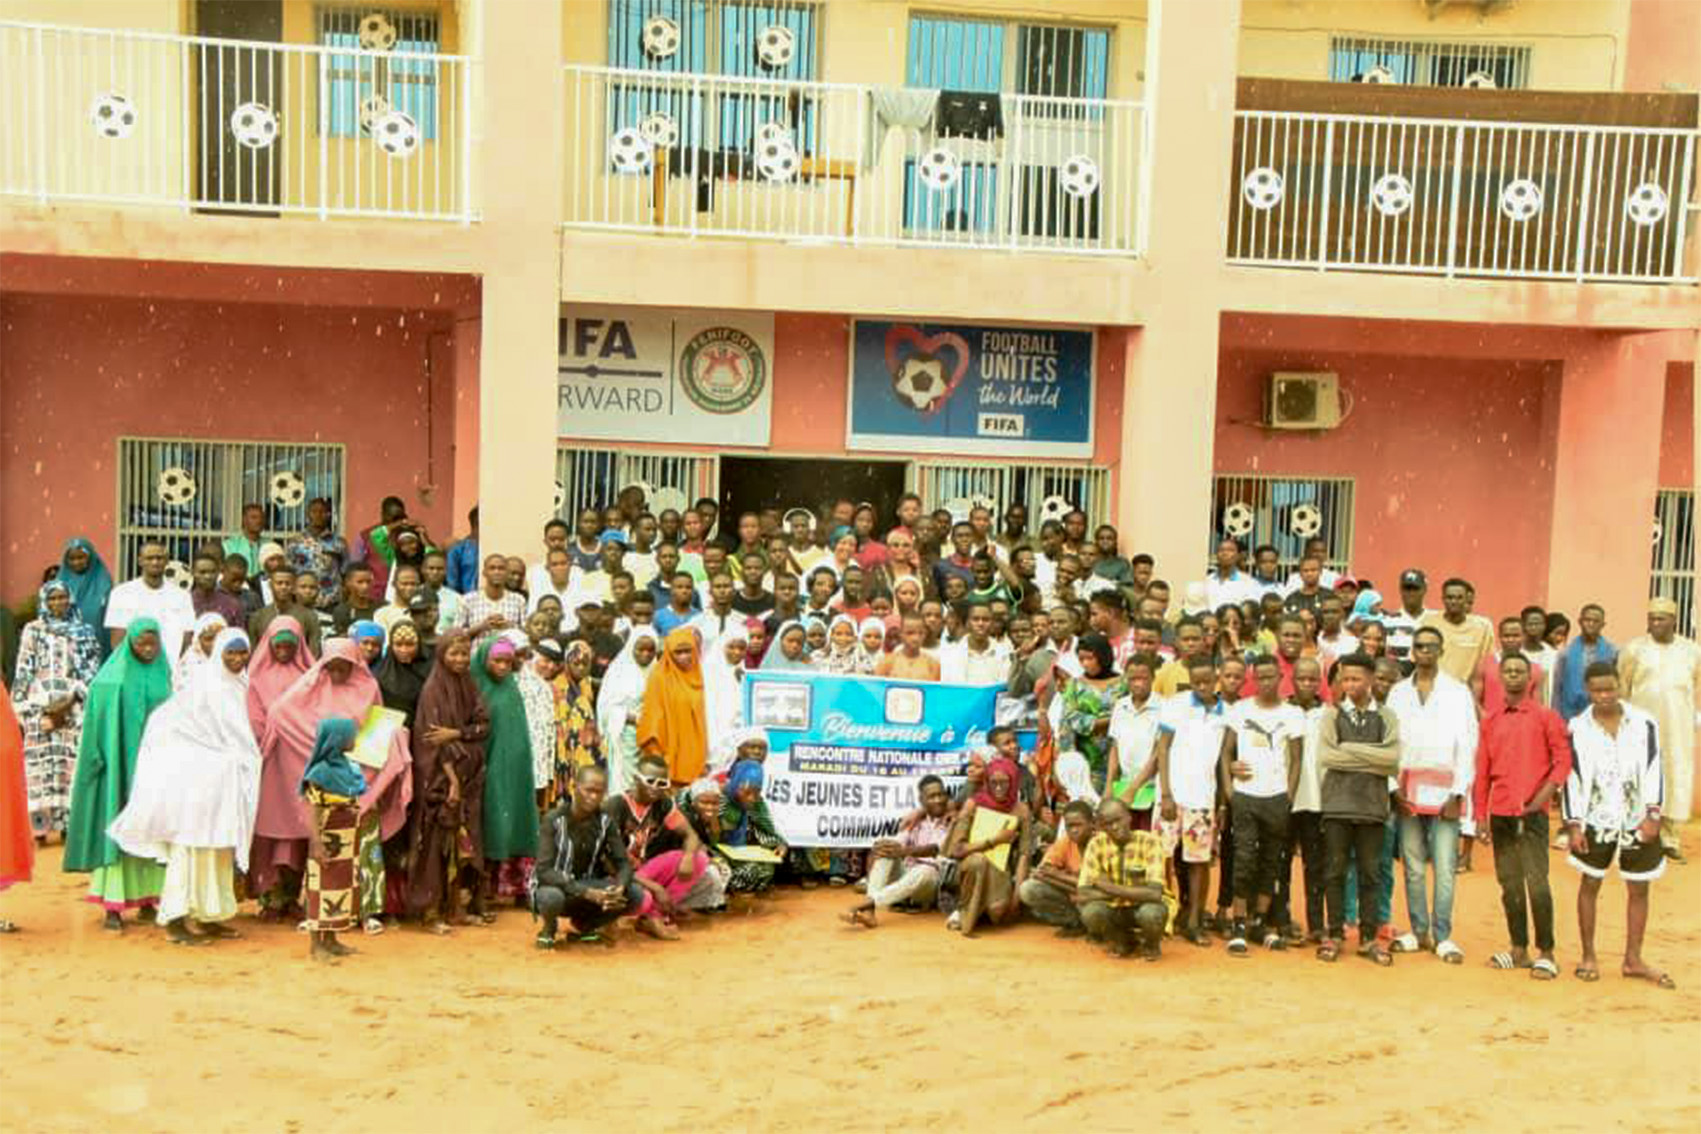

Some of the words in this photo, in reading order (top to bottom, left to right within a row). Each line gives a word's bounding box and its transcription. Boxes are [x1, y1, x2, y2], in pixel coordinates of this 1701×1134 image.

[559, 318, 637, 359] IFA
[981, 332, 1058, 354] FOOTBALL
[980, 354, 1058, 382] UNITES
[559, 384, 663, 413] RWARD
[978, 384, 1006, 405] the
[1008, 384, 1061, 409] World
[984, 417, 1018, 432] FIFA
[794, 745, 865, 762] RENCONTRE
[868, 749, 931, 765] NATIONALE
[800, 762, 847, 773] MARADI
[765, 778, 791, 802] LES
[796, 781, 863, 807] JEUNES
[868, 785, 889, 808] ET
[895, 785, 915, 808] LA
